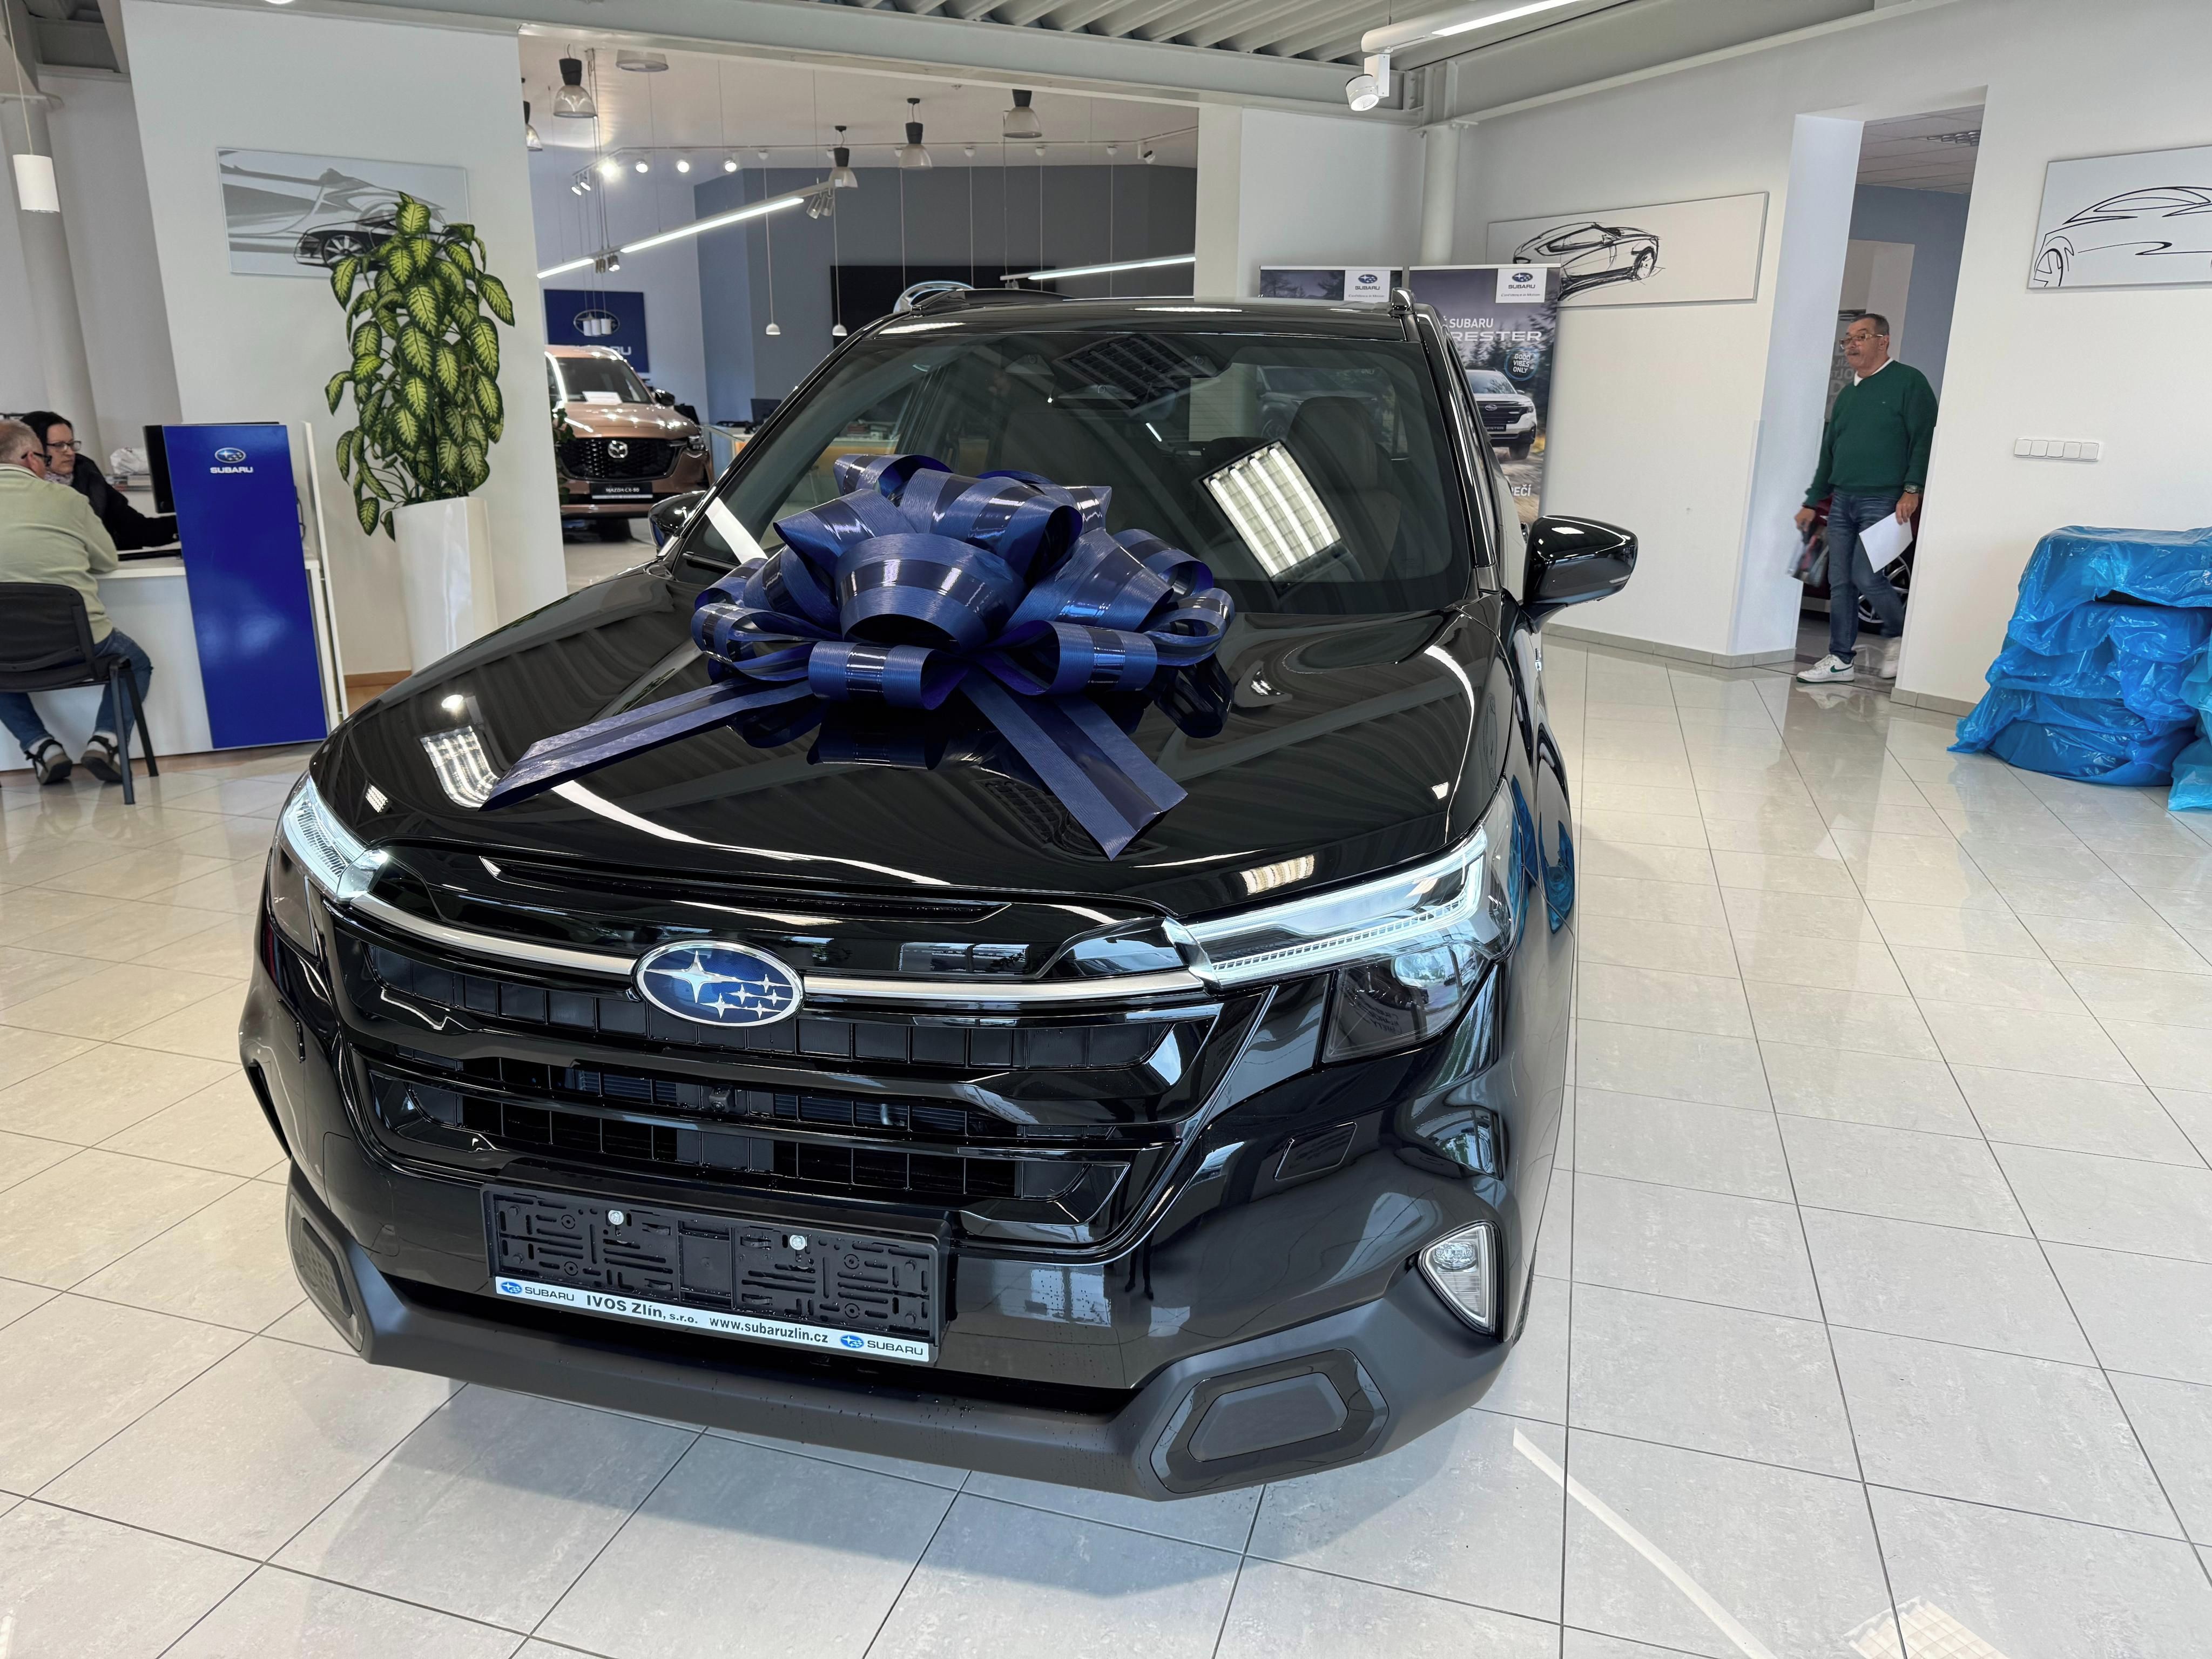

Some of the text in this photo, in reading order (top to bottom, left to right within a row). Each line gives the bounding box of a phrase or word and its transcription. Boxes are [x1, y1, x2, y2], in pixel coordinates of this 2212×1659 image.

[1449, 318, 1494, 328] SUBARU
[1449, 331, 1542, 341] RESTER
[524, 1286, 923, 1356] SUBARU IVOS Zlín, s.r.o. www.subaruzlin.cz SUBARU
